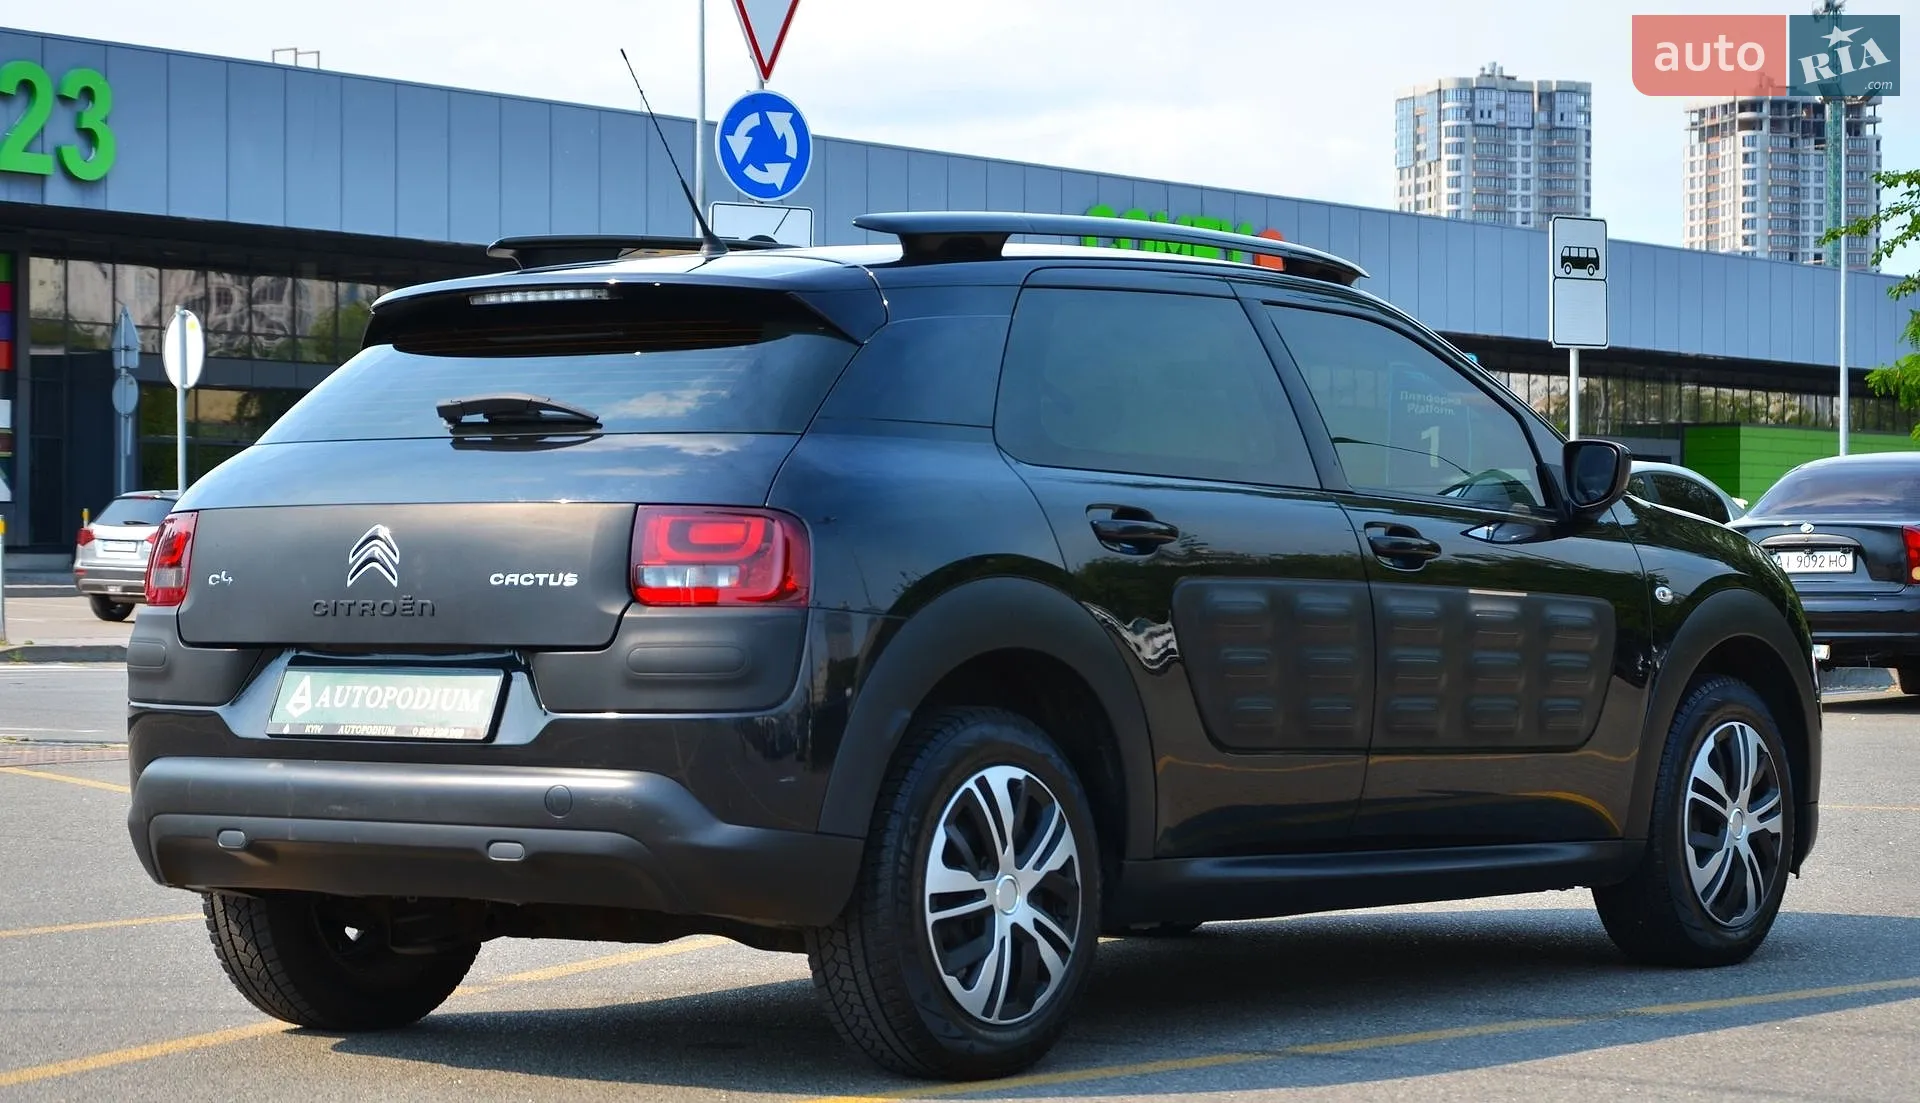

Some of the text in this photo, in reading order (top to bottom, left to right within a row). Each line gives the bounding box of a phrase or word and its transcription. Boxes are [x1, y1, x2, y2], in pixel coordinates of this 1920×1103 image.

[0, 60, 118, 182] 23
[1421, 425, 1440, 468] 1
[1796, 554, 1826, 569] 9092
[489, 572, 579, 587] CACTUS
[314, 685, 486, 713] AUTOPODIUM
[338, 725, 397, 736] AUTOPODIUM
